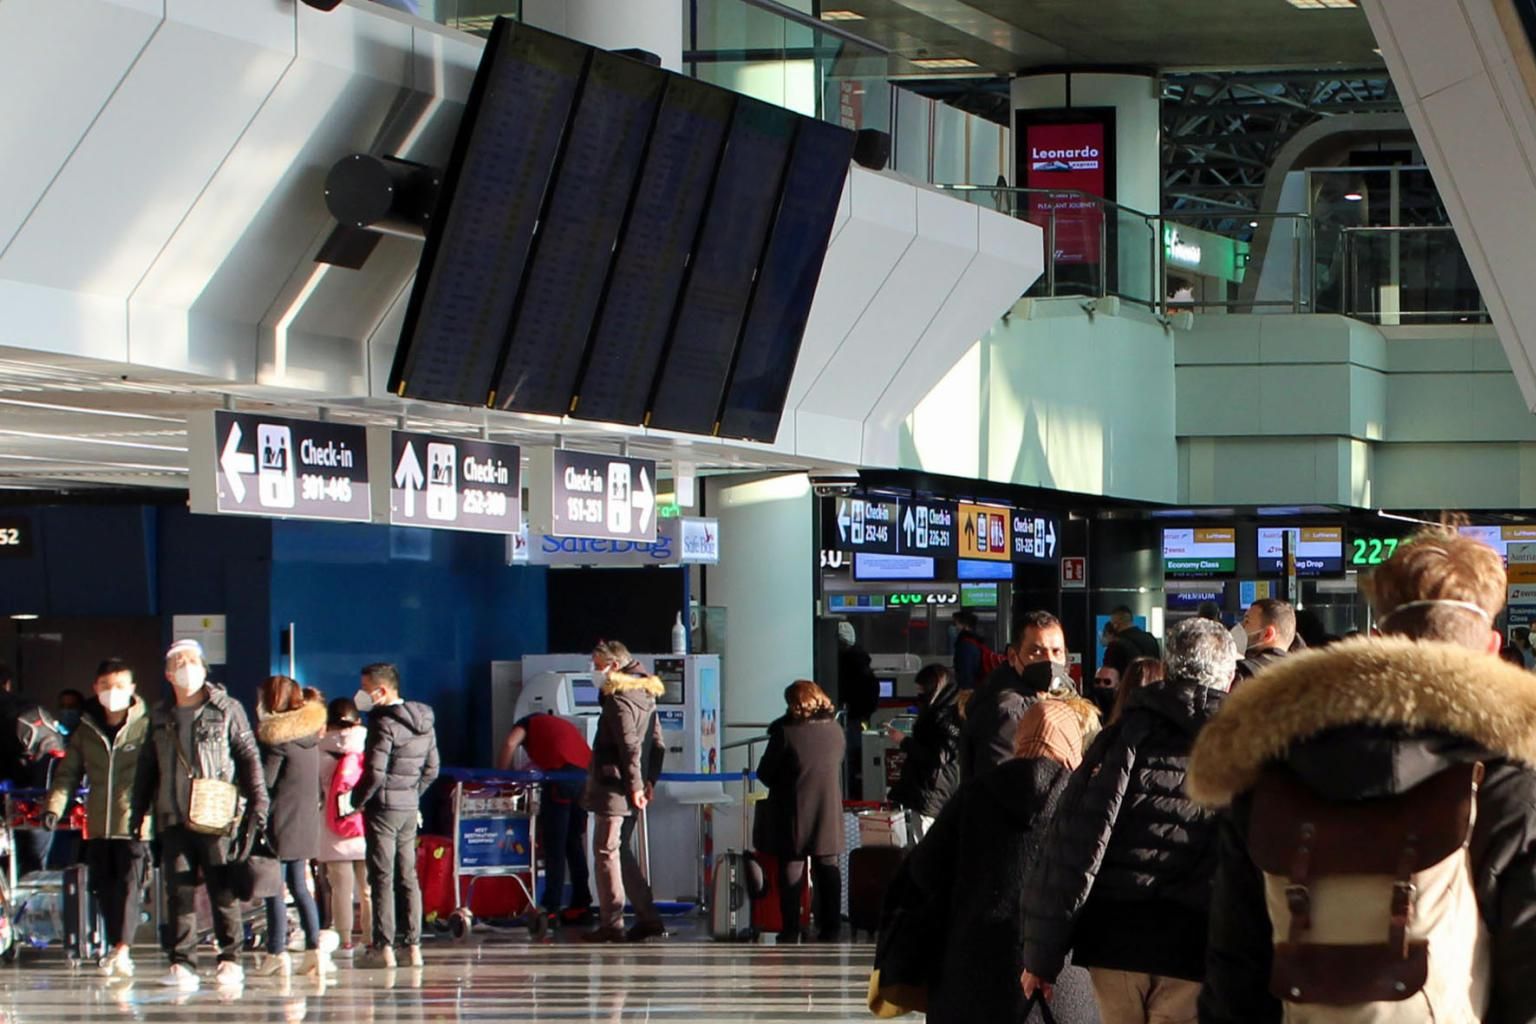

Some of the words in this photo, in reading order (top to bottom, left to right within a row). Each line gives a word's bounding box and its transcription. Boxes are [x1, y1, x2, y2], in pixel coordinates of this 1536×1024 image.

[1032, 146, 1099, 159] Leonardo
[301, 438, 353, 468] Check-in
[463, 455, 509, 485] Check-in
[564, 465, 603, 493] Check-in
[865, 502, 890, 521] Check-in
[929, 508, 952, 526] Check-in
[1013, 516, 1034, 534] Check-in
[1352, 538, 1399, 565] 227
